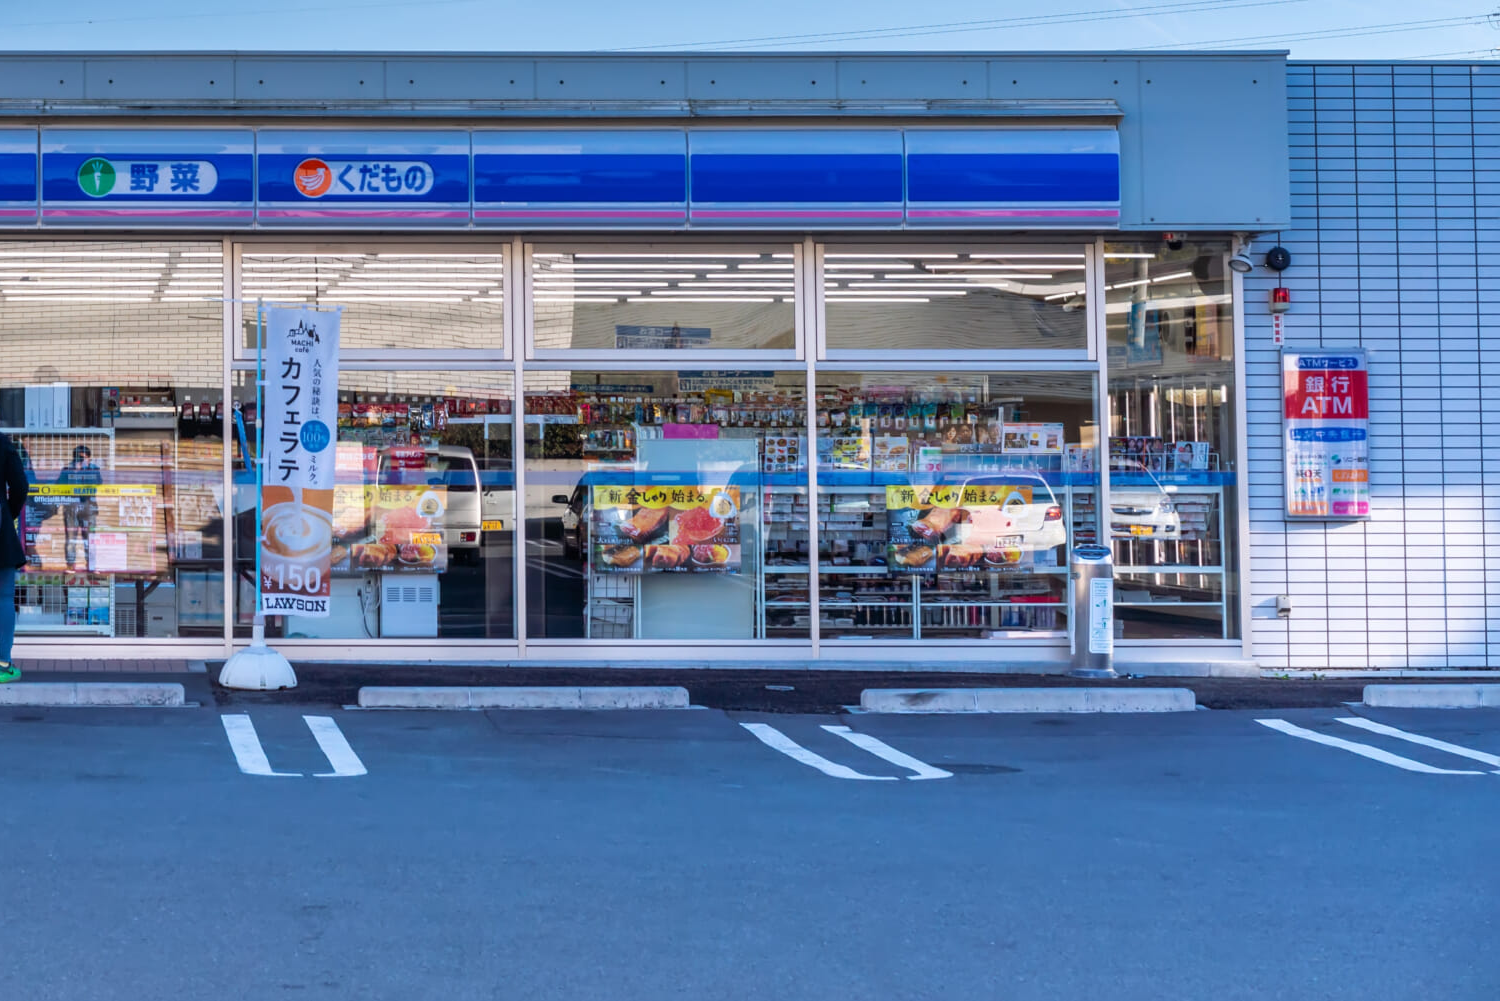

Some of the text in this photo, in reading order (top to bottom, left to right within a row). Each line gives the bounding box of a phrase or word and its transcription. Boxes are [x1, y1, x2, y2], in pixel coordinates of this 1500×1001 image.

[130, 163, 200, 193] 野菜
[336, 165, 427, 193] くだもの
[291, 339, 314, 348] MACHI
[1299, 359, 1355, 368] ATMサービス
[1305, 375, 1350, 394] 銀行
[1301, 396, 1353, 415] ATM
[278, 356, 301, 483] カフェラテ
[608, 489, 622, 504] 新
[900, 489, 914, 504] 新
[265, 597, 327, 612] LAWSON
